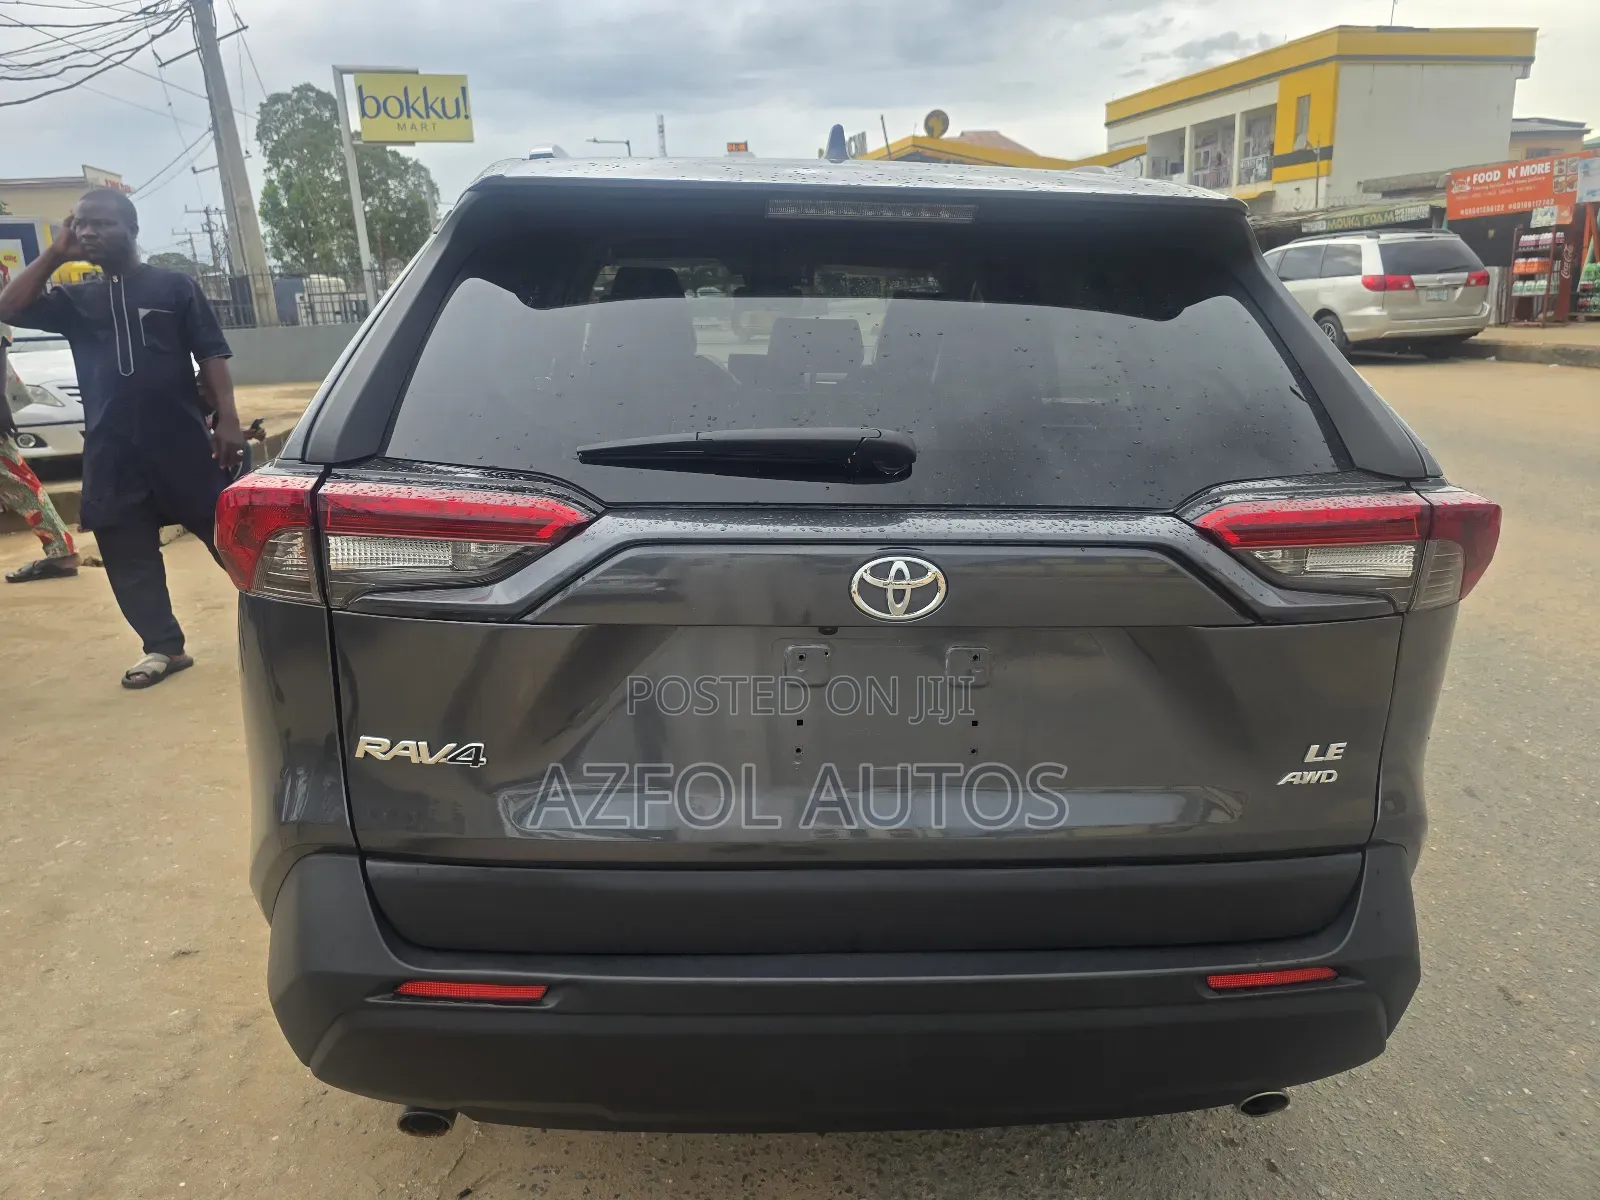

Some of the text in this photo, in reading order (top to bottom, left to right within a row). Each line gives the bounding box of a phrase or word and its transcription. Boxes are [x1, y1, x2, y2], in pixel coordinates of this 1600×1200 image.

[358, 84, 469, 120] bokku!
[396, 122, 437, 132] MART
[1472, 170, 1501, 185] FOOD
[1520, 162, 1551, 177] MORE
[1363, 211, 1396, 227] FOAM
[355, 735, 487, 768] RAV4
[1304, 742, 1347, 763] LE
[1276, 770, 1338, 786] AWD
